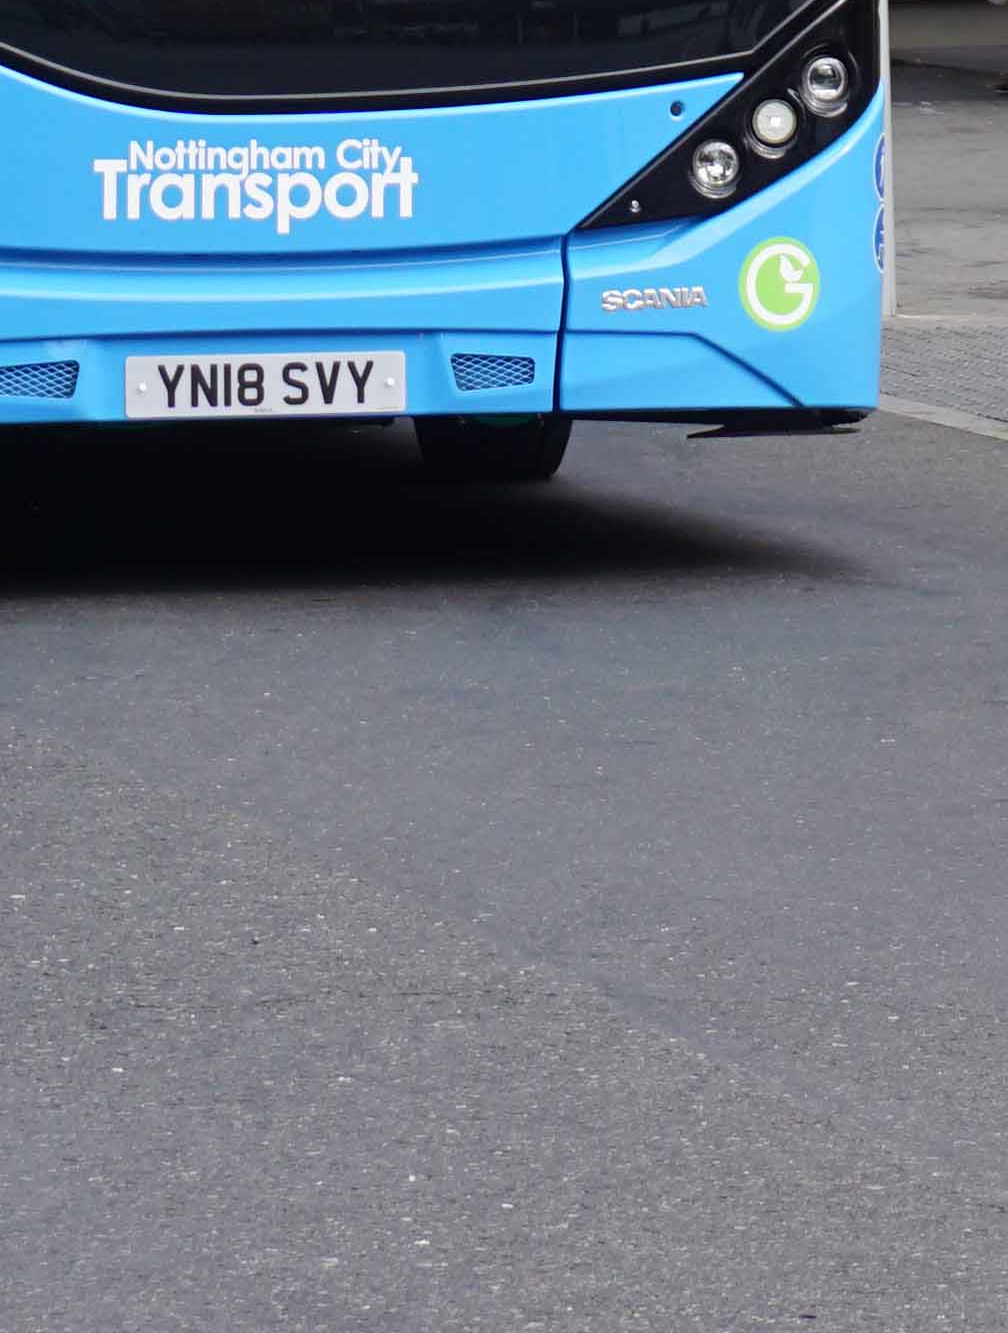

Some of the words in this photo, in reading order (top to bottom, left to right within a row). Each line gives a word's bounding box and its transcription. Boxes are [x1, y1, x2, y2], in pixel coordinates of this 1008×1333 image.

[129, 139, 326, 182] Nottingham
[335, 139, 402, 175] City
[93, 156, 419, 235] Transport
[601, 285, 708, 313] SCANIA
[157, 362, 265, 409] YN18
[282, 360, 374, 406] SVY
